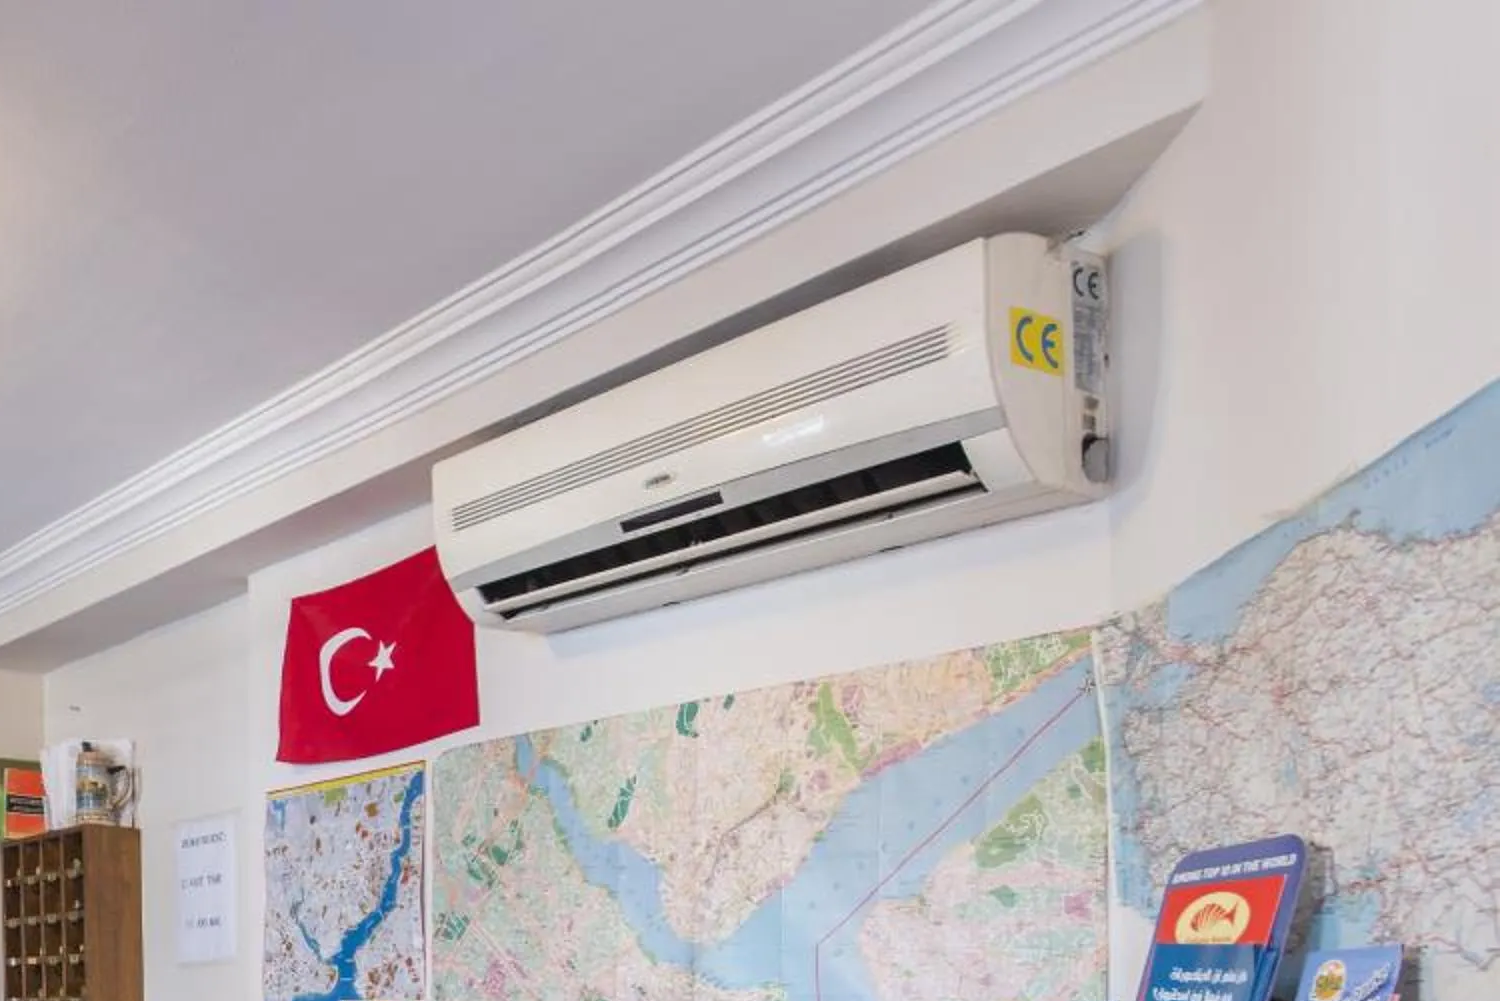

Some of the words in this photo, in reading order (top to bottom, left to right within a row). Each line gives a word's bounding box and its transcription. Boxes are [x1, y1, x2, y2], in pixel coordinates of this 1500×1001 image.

[1072, 266, 1100, 301] CE
[1015, 315, 1060, 370] CE
[1261, 853, 1297, 871] WORLD
